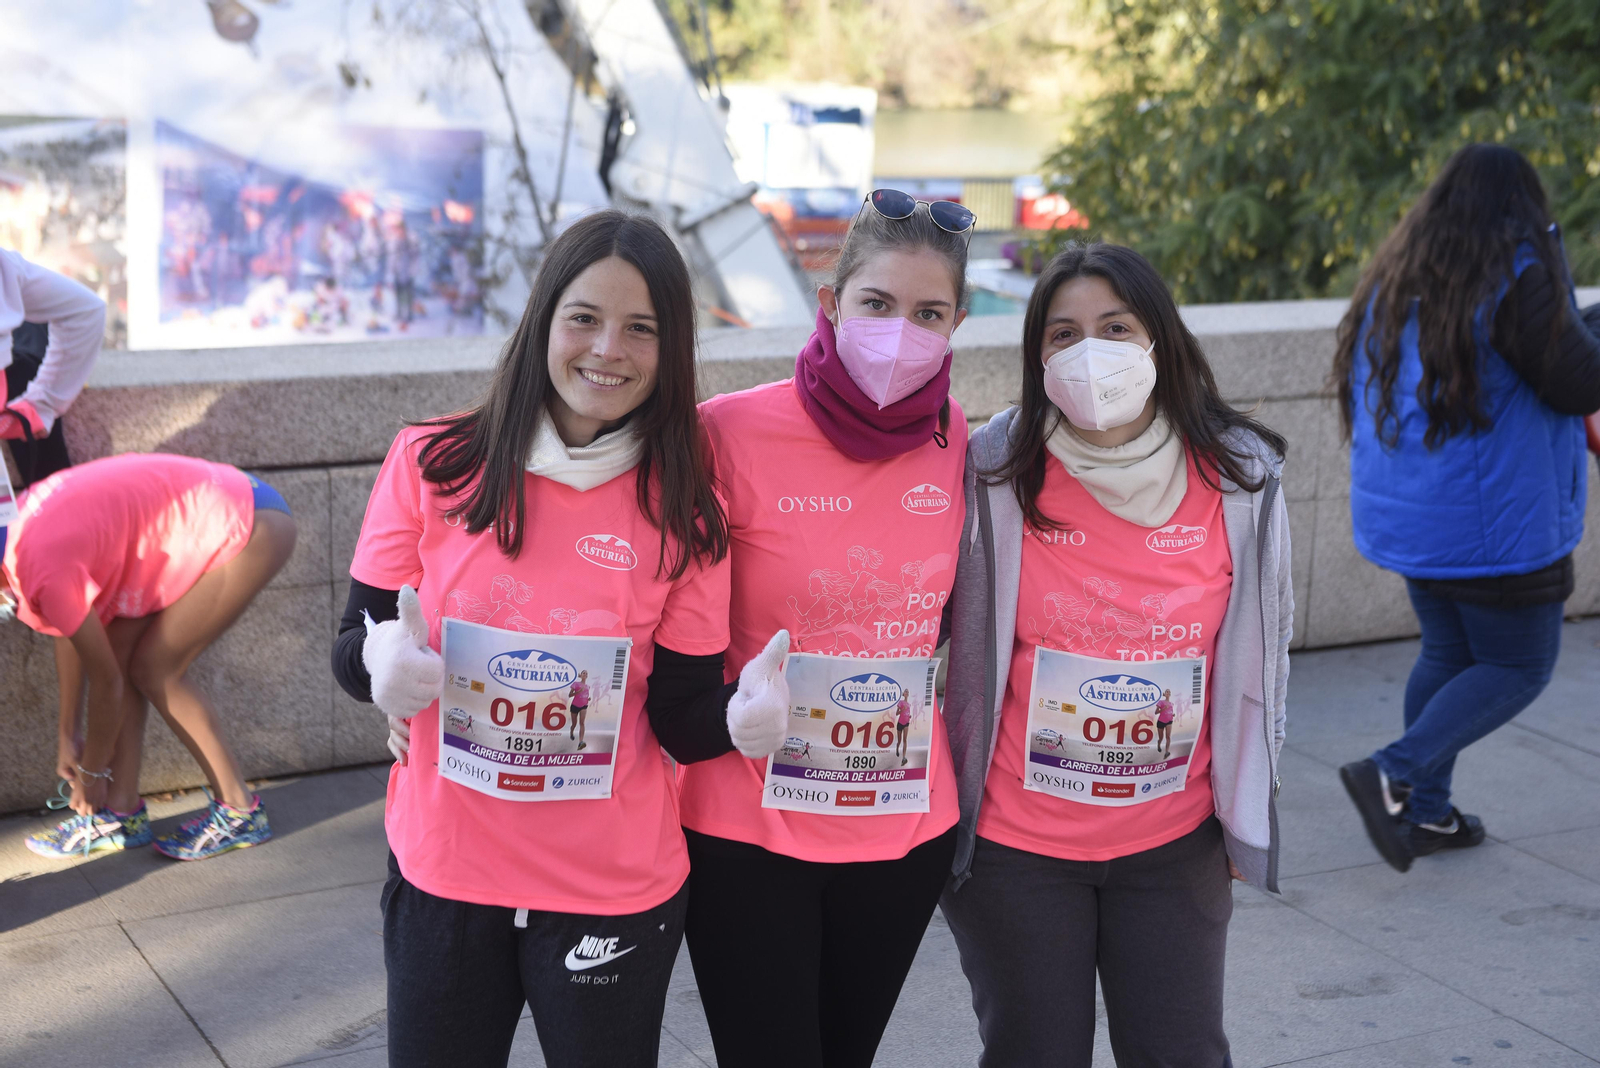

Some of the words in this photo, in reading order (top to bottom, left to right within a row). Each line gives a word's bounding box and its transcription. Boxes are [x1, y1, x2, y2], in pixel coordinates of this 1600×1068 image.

[777, 496, 853, 513] OYSHO
[907, 496, 949, 508] ASTURIANA
[1151, 534, 1204, 548] ASTURIANA
[580, 540, 632, 567] ASTURIAN
[907, 590, 946, 611] POR
[873, 616, 938, 640] TODAS
[1152, 622, 1203, 642] POR
[493, 660, 570, 683] ASTURIANA
[507, 660, 537, 669] CENTRAL
[836, 686, 897, 703] ASTURIANA
[1085, 684, 1155, 702] ASTURIANA
[490, 697, 567, 731] 016
[830, 721, 894, 748] 016
[1083, 717, 1154, 745] 016
[505, 736, 543, 752] 1891
[469, 743, 511, 763] CARRERA
[514, 755, 530, 765] DE
[531, 755, 545, 765] LA
[547, 755, 584, 765] MUJER
[844, 755, 877, 769] 1890
[1098, 750, 1134, 764] 1892
[447, 756, 491, 782] OYSHO
[804, 769, 849, 781] CARRERA
[852, 772, 864, 781] DE
[865, 772, 878, 781] LA
[878, 770, 906, 781] MUJER
[1059, 759, 1104, 774] CARRERA
[1107, 766, 1121, 775] DE
[1122, 767, 1135, 776] LA
[1137, 762, 1168, 775] MUJER
[511, 779, 539, 787] Santander
[568, 778, 600, 786] ZURICH
[1033, 772, 1085, 792] OYSHO
[1153, 776, 1178, 789] ZURICH
[773, 785, 829, 803] OYSHO
[576, 934, 619, 959] NIKE
[570, 974, 591, 984] JUST
[594, 975, 609, 985] DO
[611, 974, 619, 984] IT
